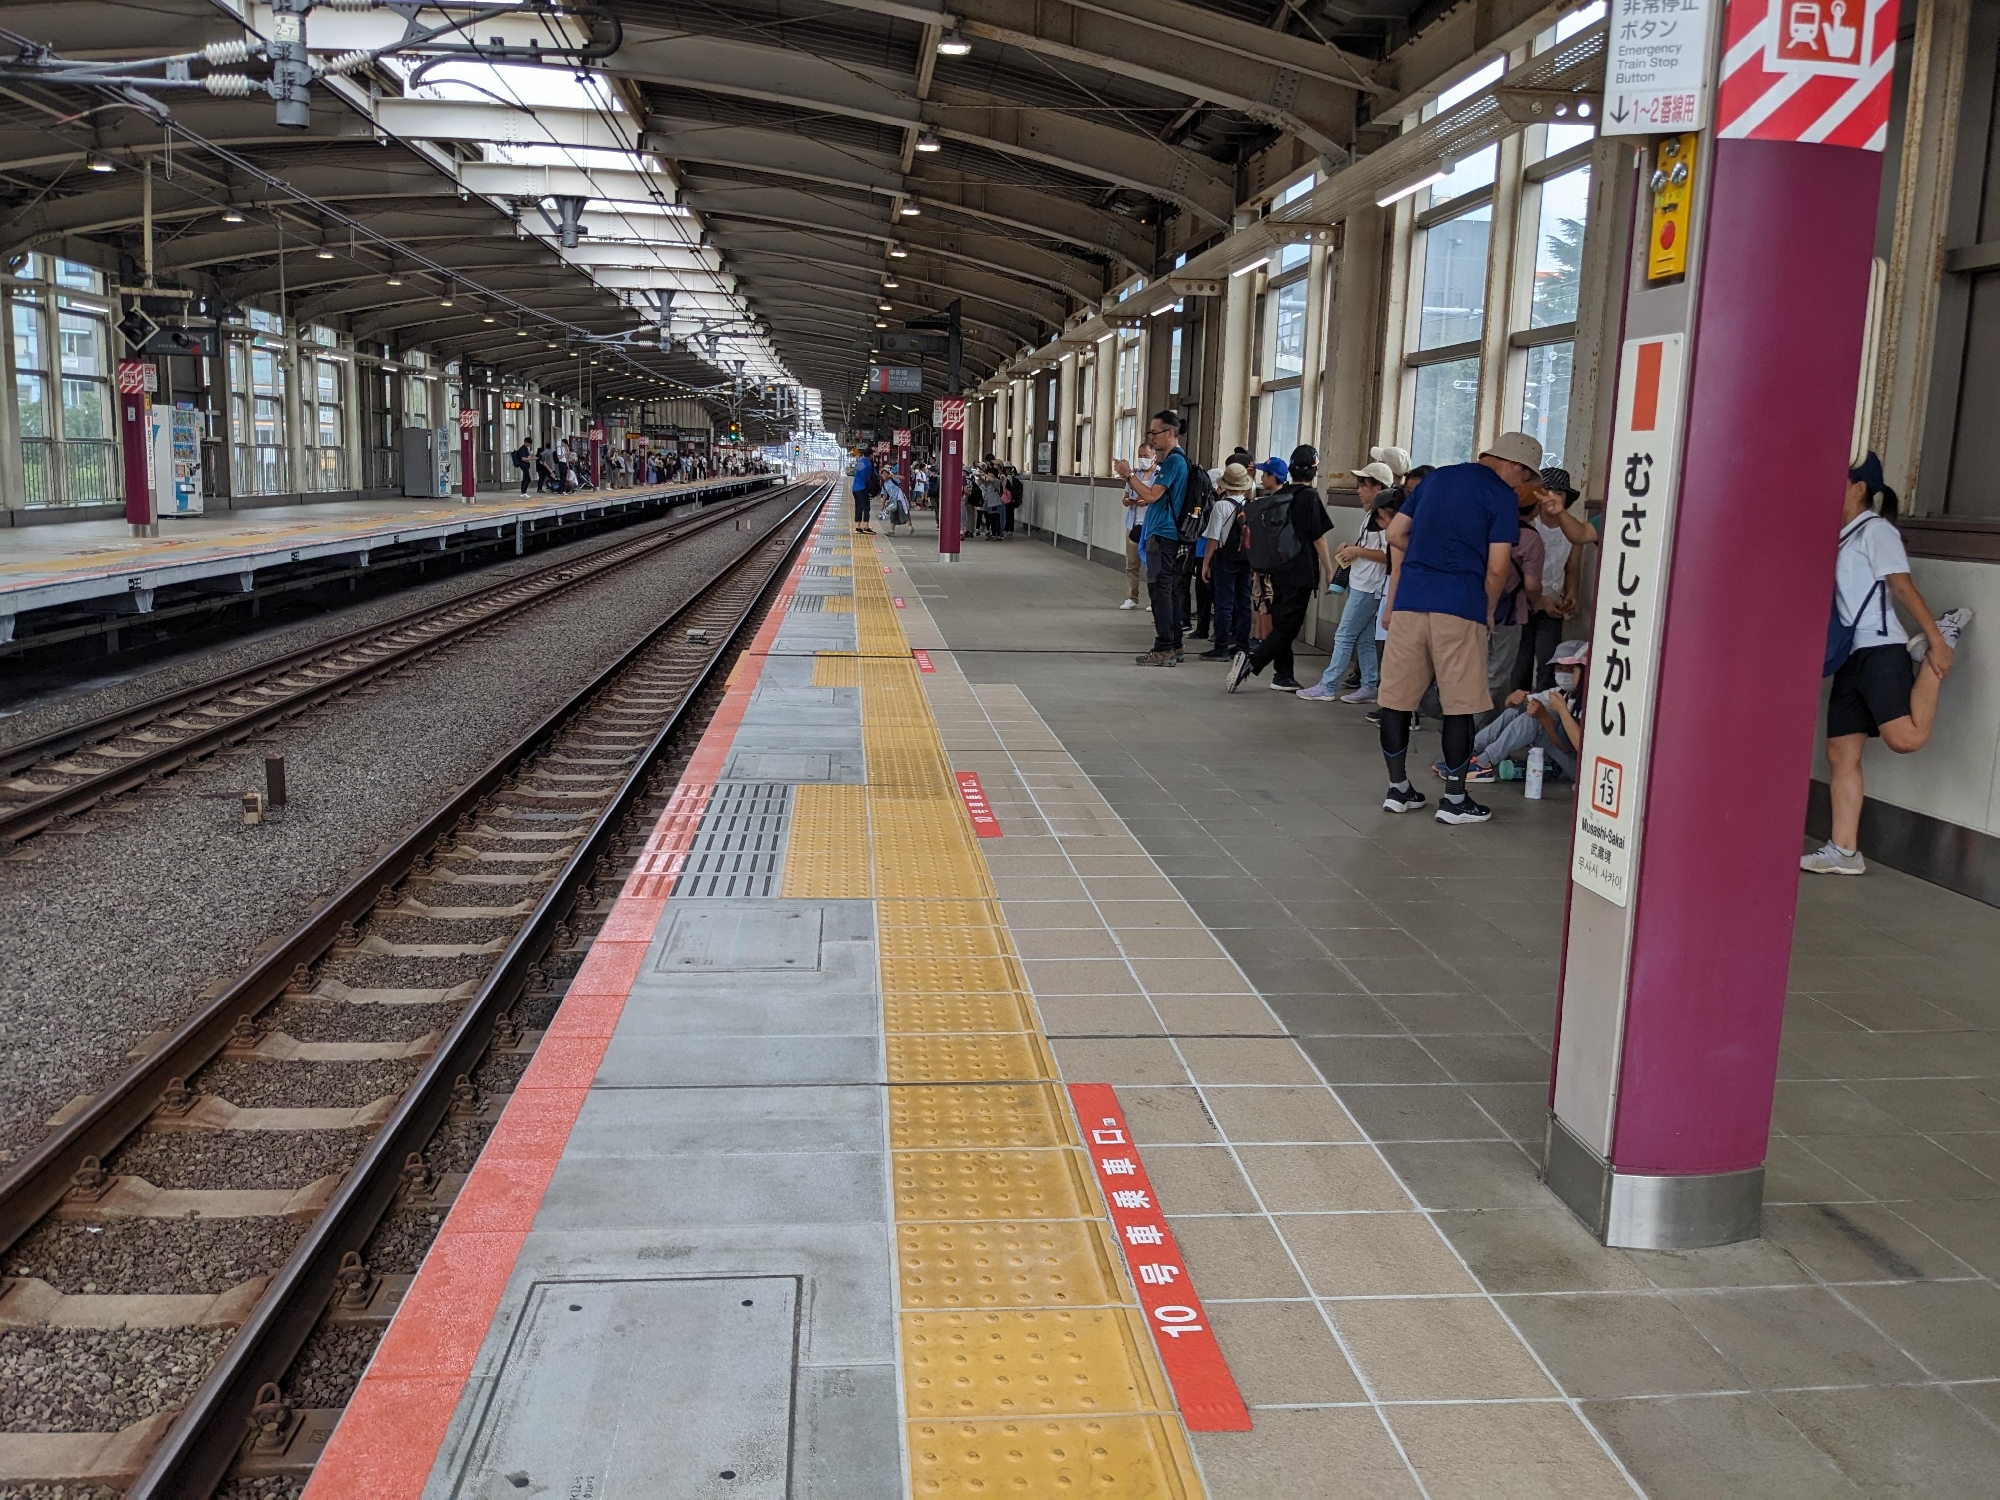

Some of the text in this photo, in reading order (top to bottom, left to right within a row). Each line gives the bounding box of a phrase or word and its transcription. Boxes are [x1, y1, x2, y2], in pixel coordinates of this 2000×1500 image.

[1622, 0, 1699, 15] 非常停止
[1620, 20, 1677, 40] ボタン
[1618, 44, 1682, 56] Emergency
[1617, 57, 1679, 70] Train Stop
[1615, 73, 1656, 84] Button
[202, 335, 210, 352] 1
[871, 368, 880, 382] 2
[1600, 452, 1653, 737] むさしさかい
[1602, 767, 1614, 784] JC
[1599, 783, 1614, 806] 13
[1581, 817, 1626, 850] Musashi-Sakai
[1578, 856, 1622, 890] 무사시 사카이
[1091, 1128, 1204, 1338] 10号車乗車口
